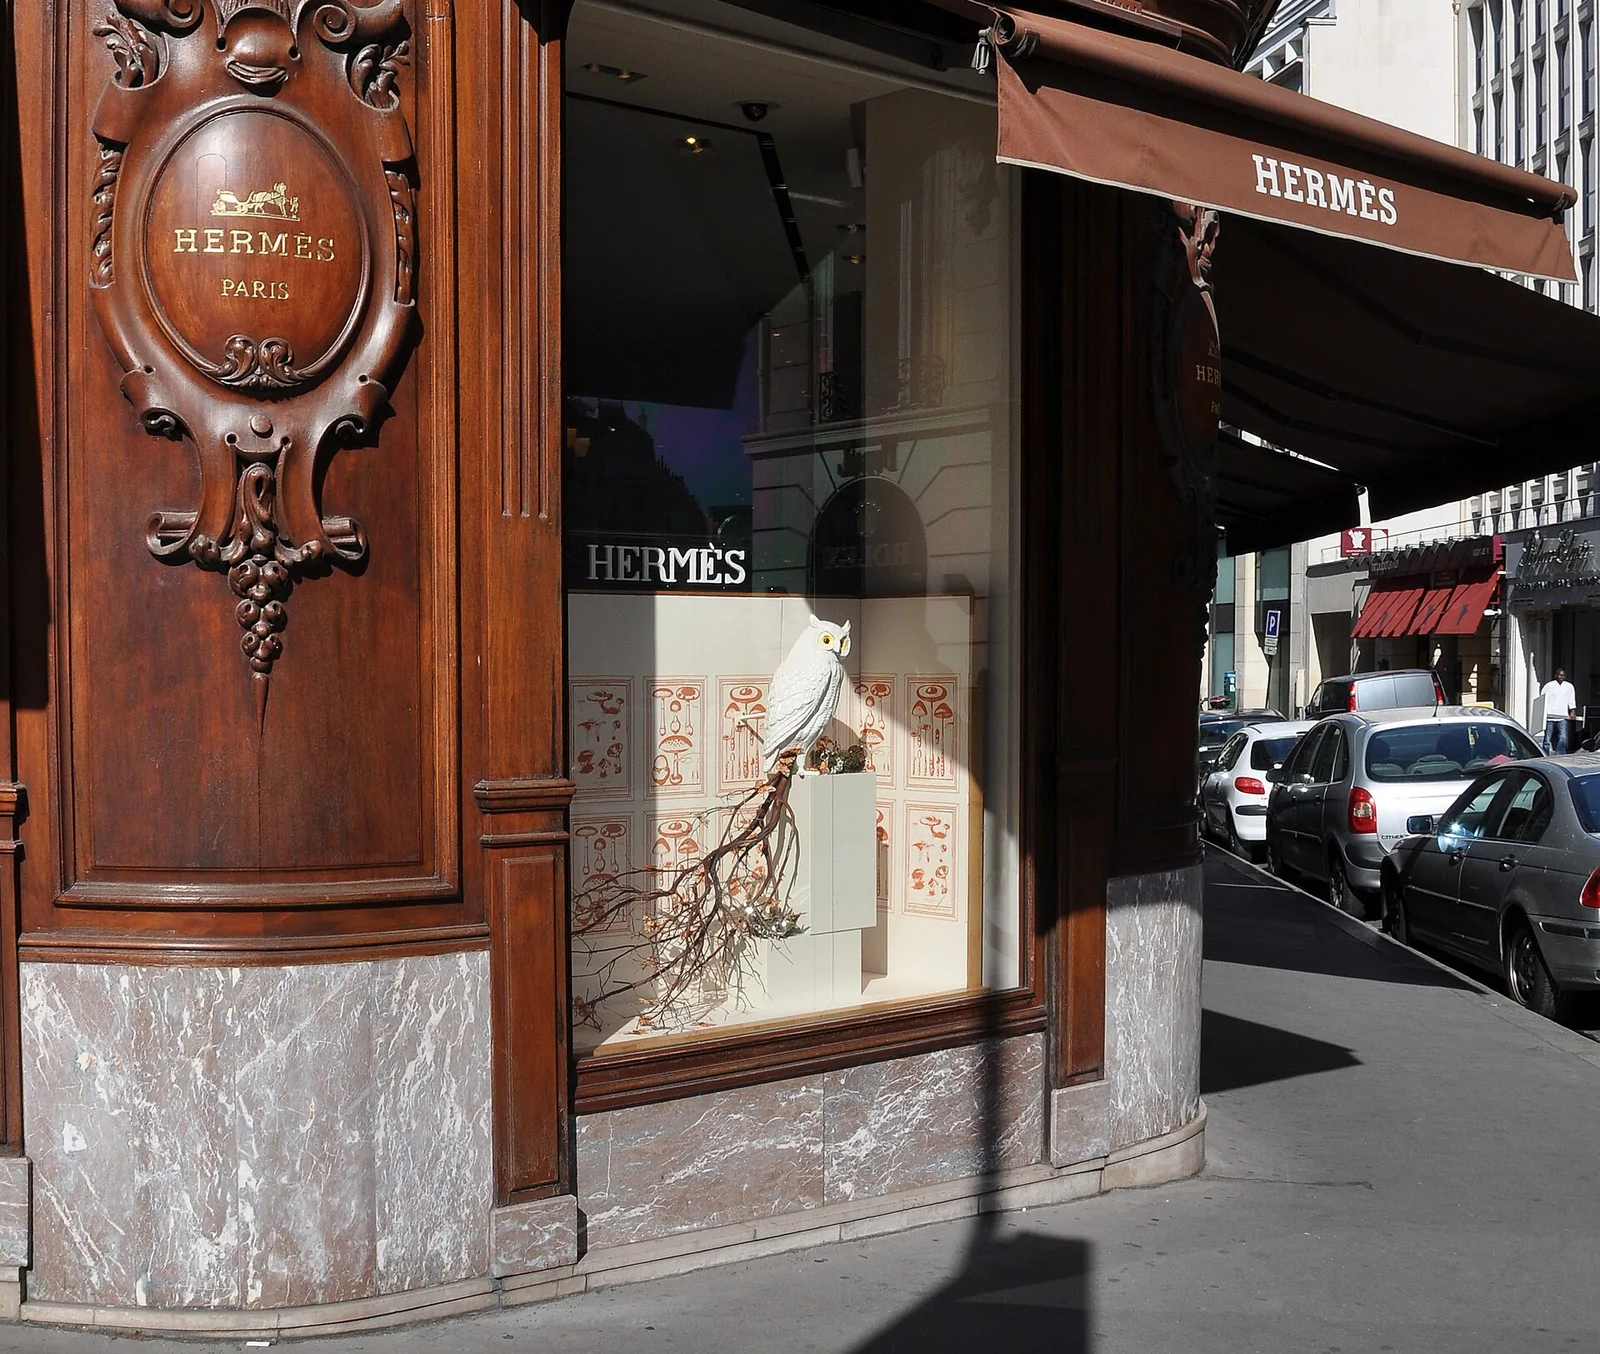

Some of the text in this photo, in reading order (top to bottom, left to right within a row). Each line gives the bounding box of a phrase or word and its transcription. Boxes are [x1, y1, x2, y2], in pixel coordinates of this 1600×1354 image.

[1251, 153, 1397, 226] HERMÈS
[220, 278, 290, 300] PARIS
[586, 541, 746, 585] HERMÈS
[1268, 615, 1276, 632] P
